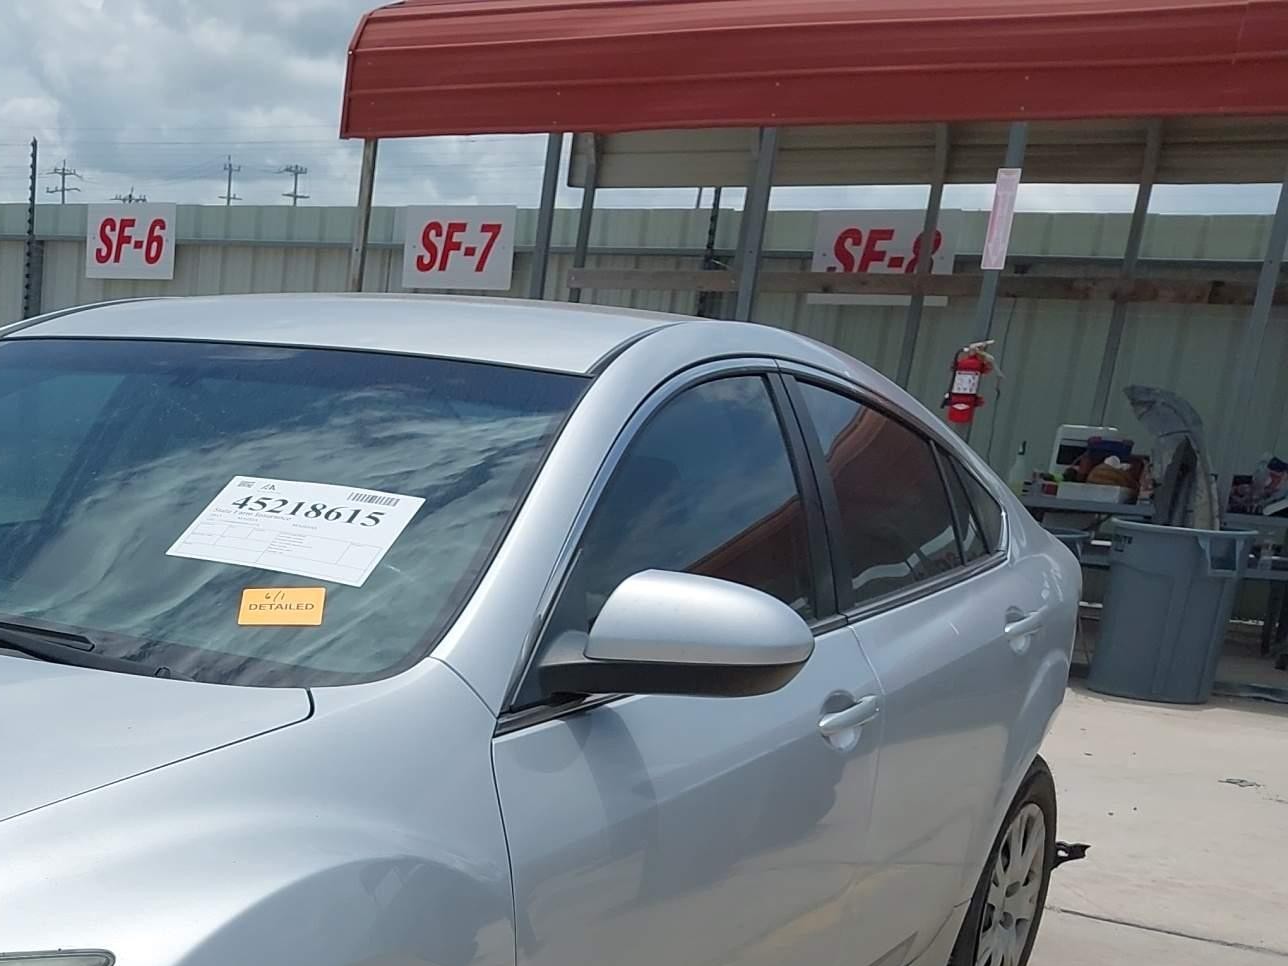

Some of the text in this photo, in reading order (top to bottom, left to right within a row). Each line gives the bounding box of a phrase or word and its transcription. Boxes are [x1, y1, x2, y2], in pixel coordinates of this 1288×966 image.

[95, 217, 166, 265] SF-6
[415, 221, 502, 272] SF-7
[232, 495, 385, 528] 45218615
[248, 603, 315, 611] DETAILED
